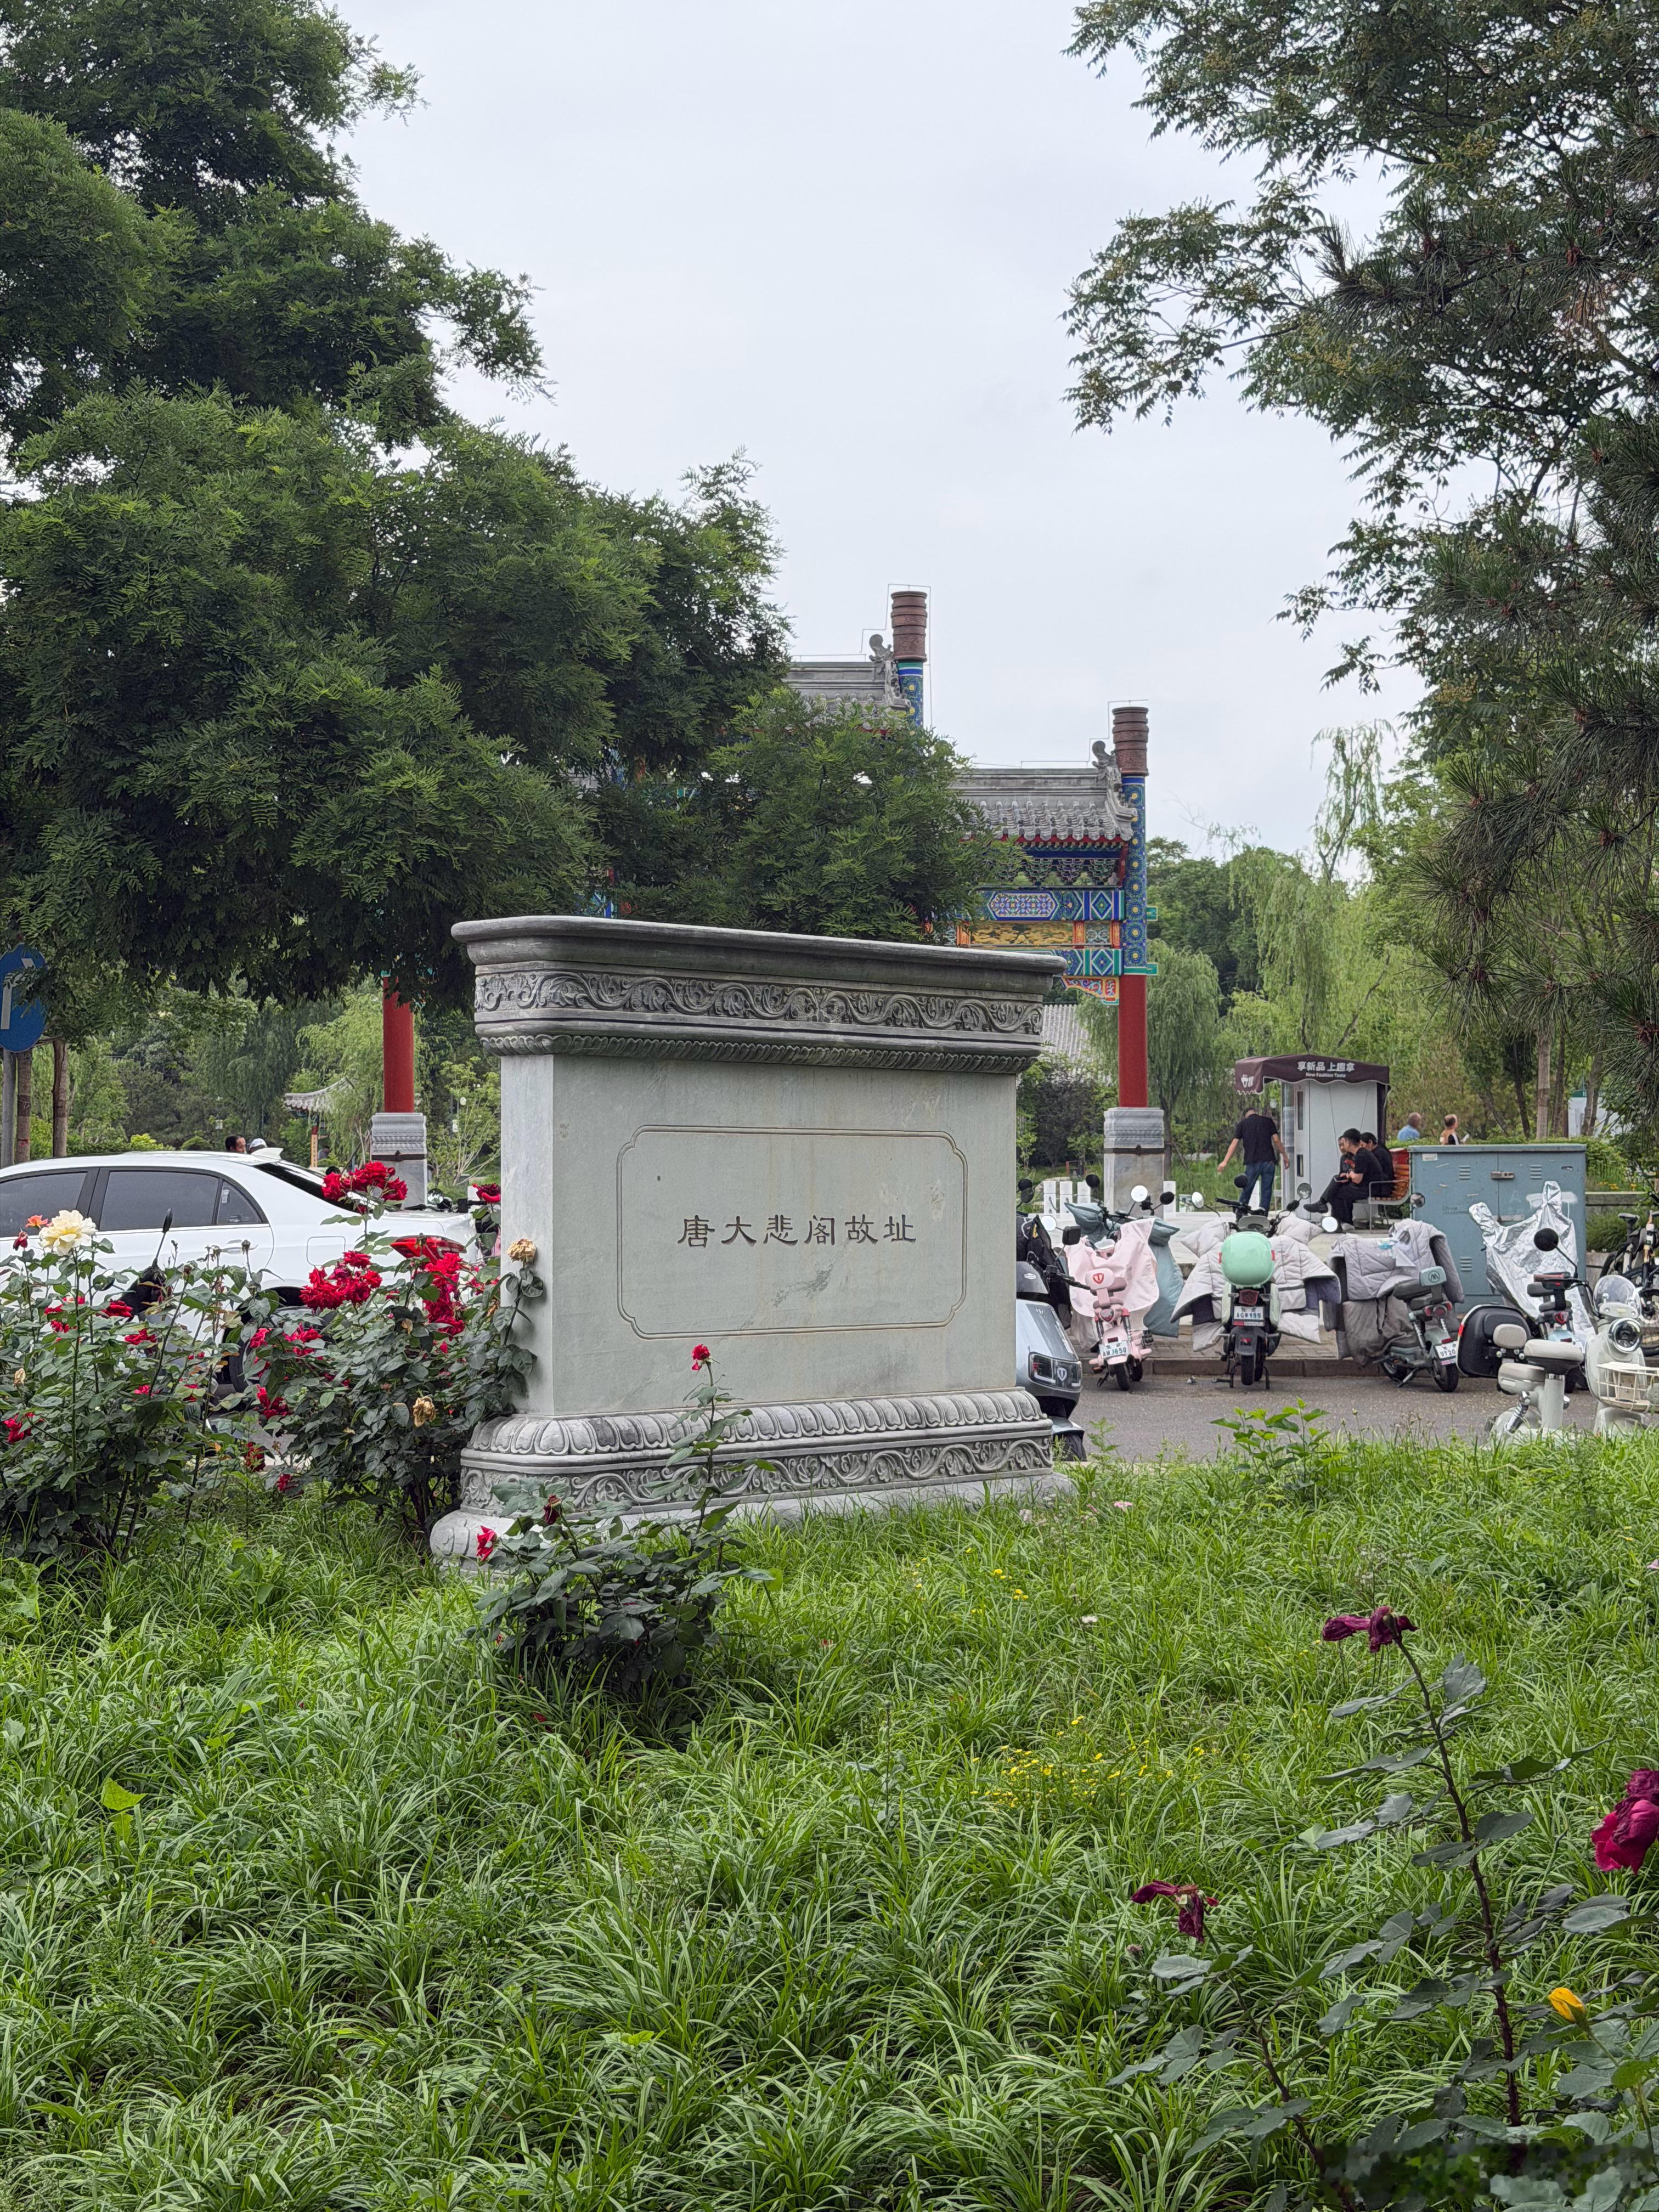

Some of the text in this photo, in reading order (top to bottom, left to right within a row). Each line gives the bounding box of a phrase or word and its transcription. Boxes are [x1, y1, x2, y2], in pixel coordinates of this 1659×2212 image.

[678, 1214, 917, 1248] 唐大悲阁故址
